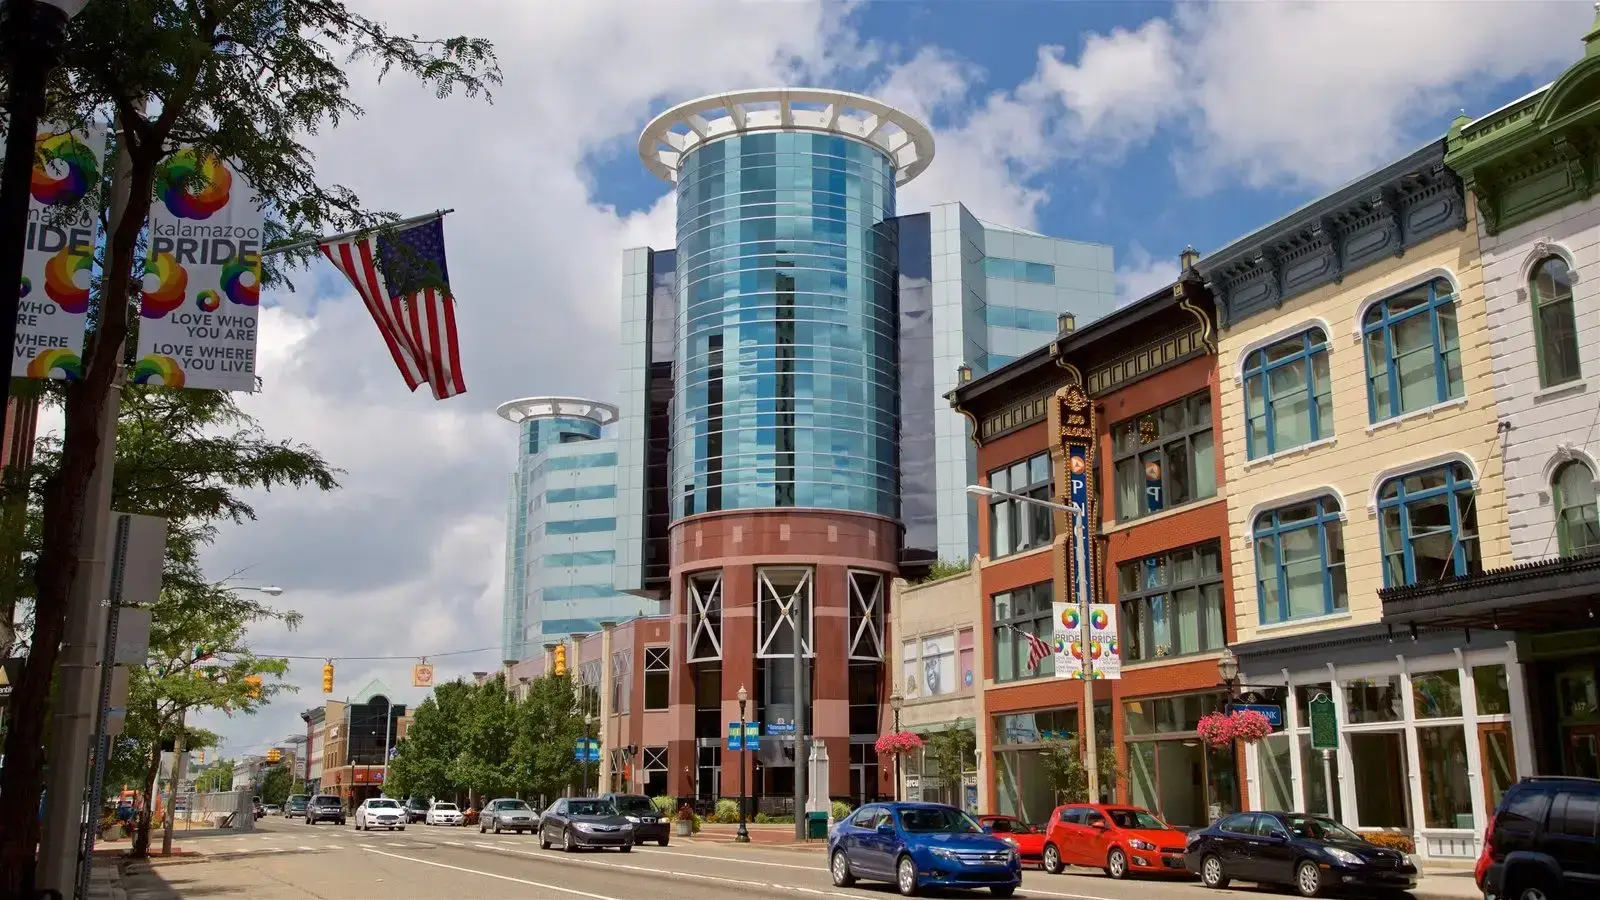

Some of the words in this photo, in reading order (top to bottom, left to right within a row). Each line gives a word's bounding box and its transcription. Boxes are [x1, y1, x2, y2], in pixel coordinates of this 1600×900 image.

[153, 218, 260, 239] kalamazoo
[152, 237, 259, 267] PRIDE
[171, 313, 212, 326] LOVE
[217, 315, 256, 329] WHO
[186, 326, 219, 339] YOU
[224, 328, 255, 341] ARE
[153, 343, 193, 357] LOVE
[199, 346, 253, 360] WHERE
[181, 358, 215, 371] YOU
[221, 360, 253, 373] LIVE
[1055, 633, 1081, 643] PRIDE
[1091, 635, 1117, 645] PRIDE
